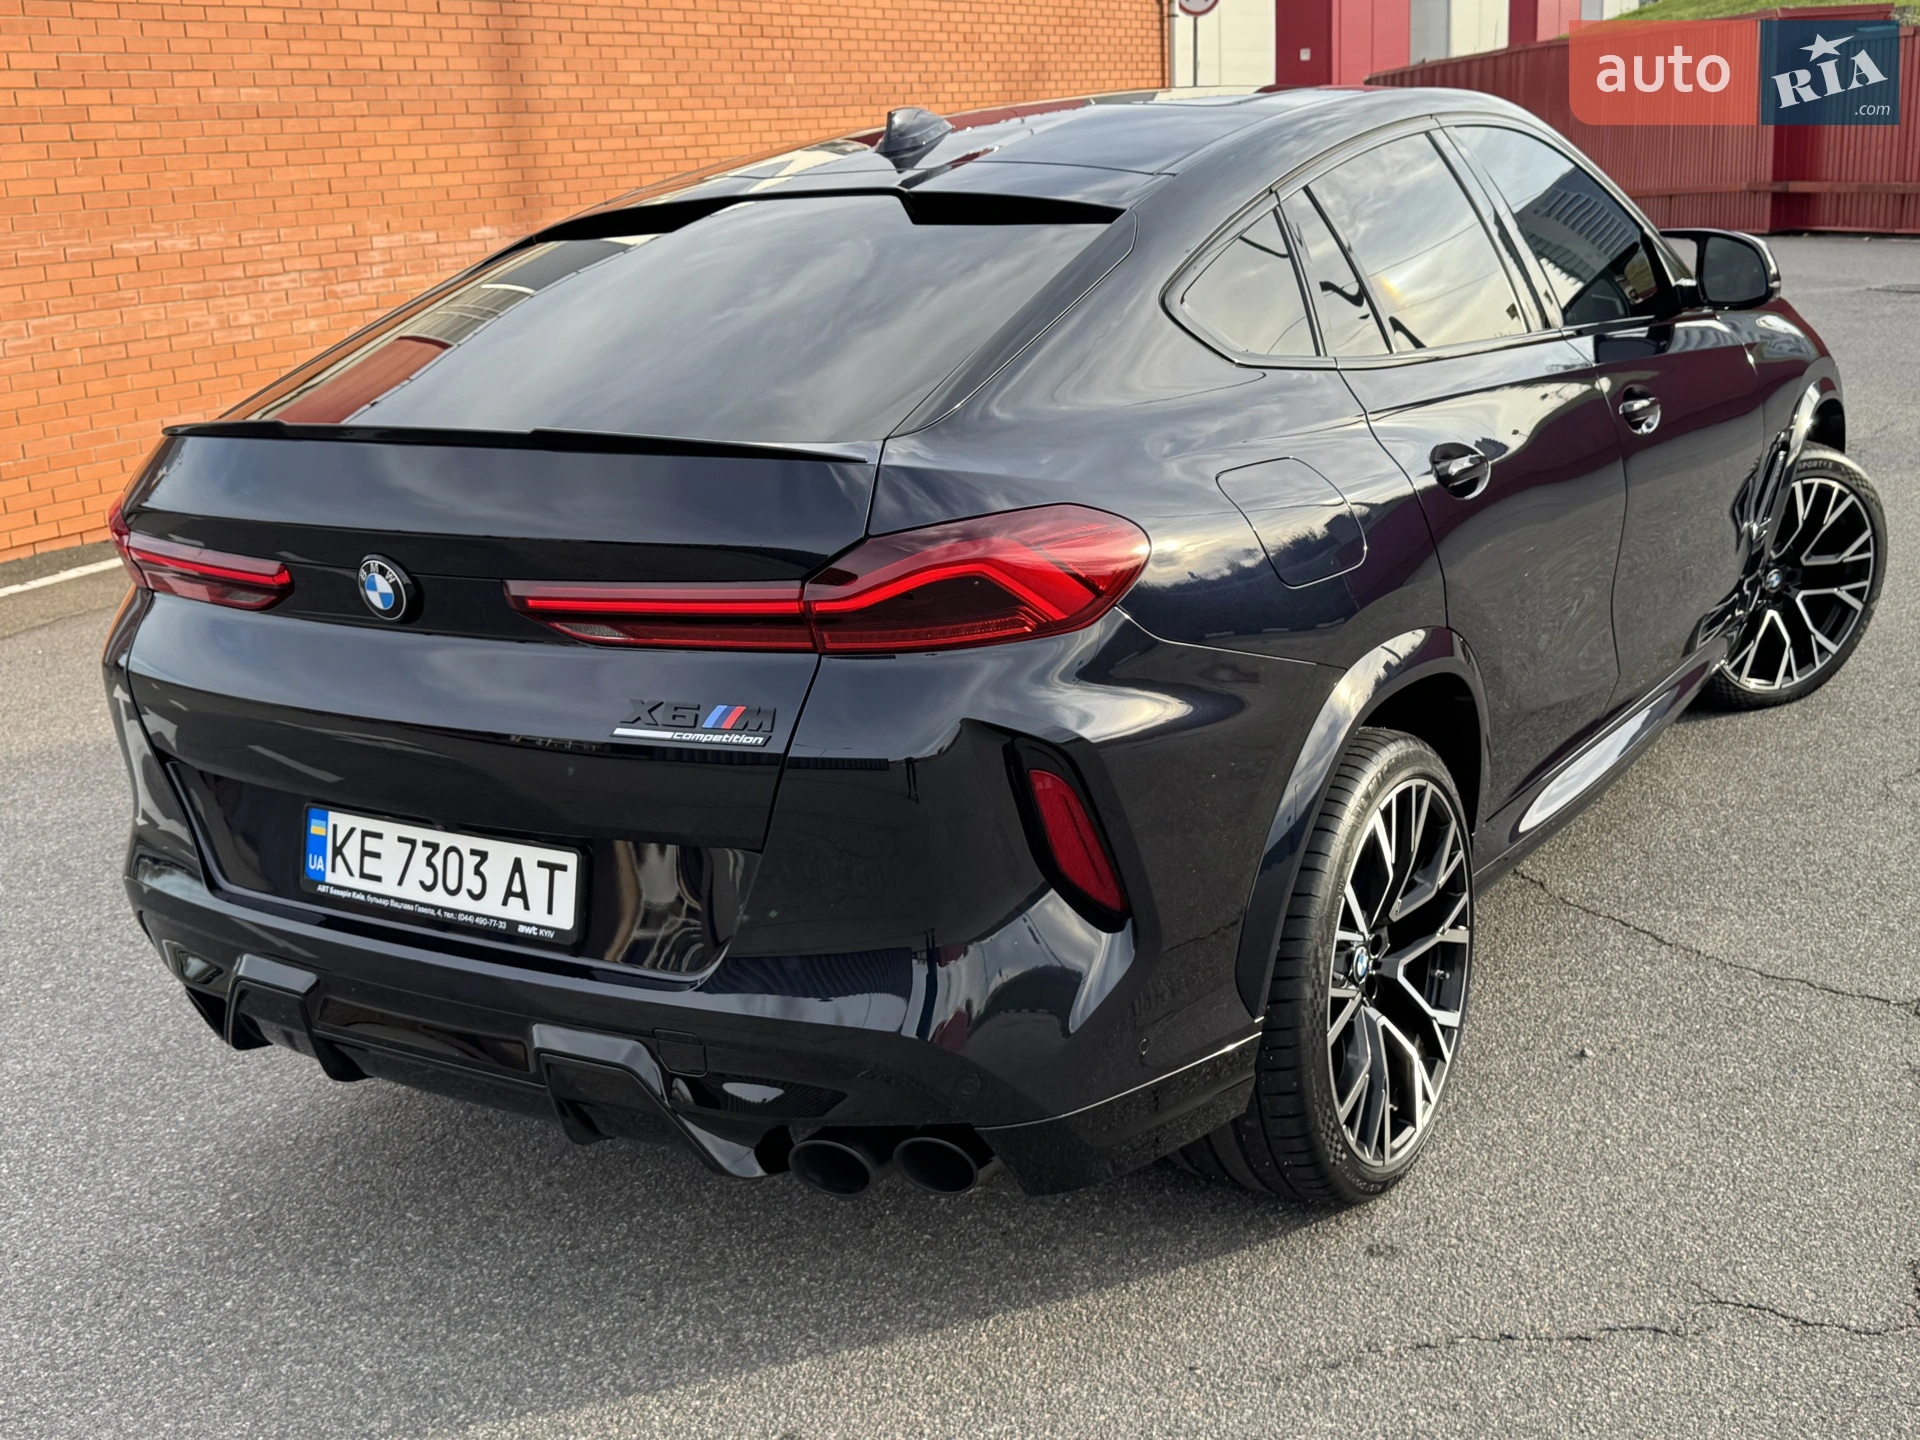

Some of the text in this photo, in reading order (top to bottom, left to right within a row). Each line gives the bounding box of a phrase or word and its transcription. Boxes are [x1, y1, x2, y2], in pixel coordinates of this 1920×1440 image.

[360, 562, 397, 584] BMW
[620, 699, 701, 728] X6
[671, 731, 764, 745] competition
[308, 853, 325, 872] UA
[330, 823, 568, 916] KE 7303 AT
[457, 912, 474, 924] (044)
[475, 915, 507, 930] 490-77-33
[517, 924, 555, 939] awt KYIV
